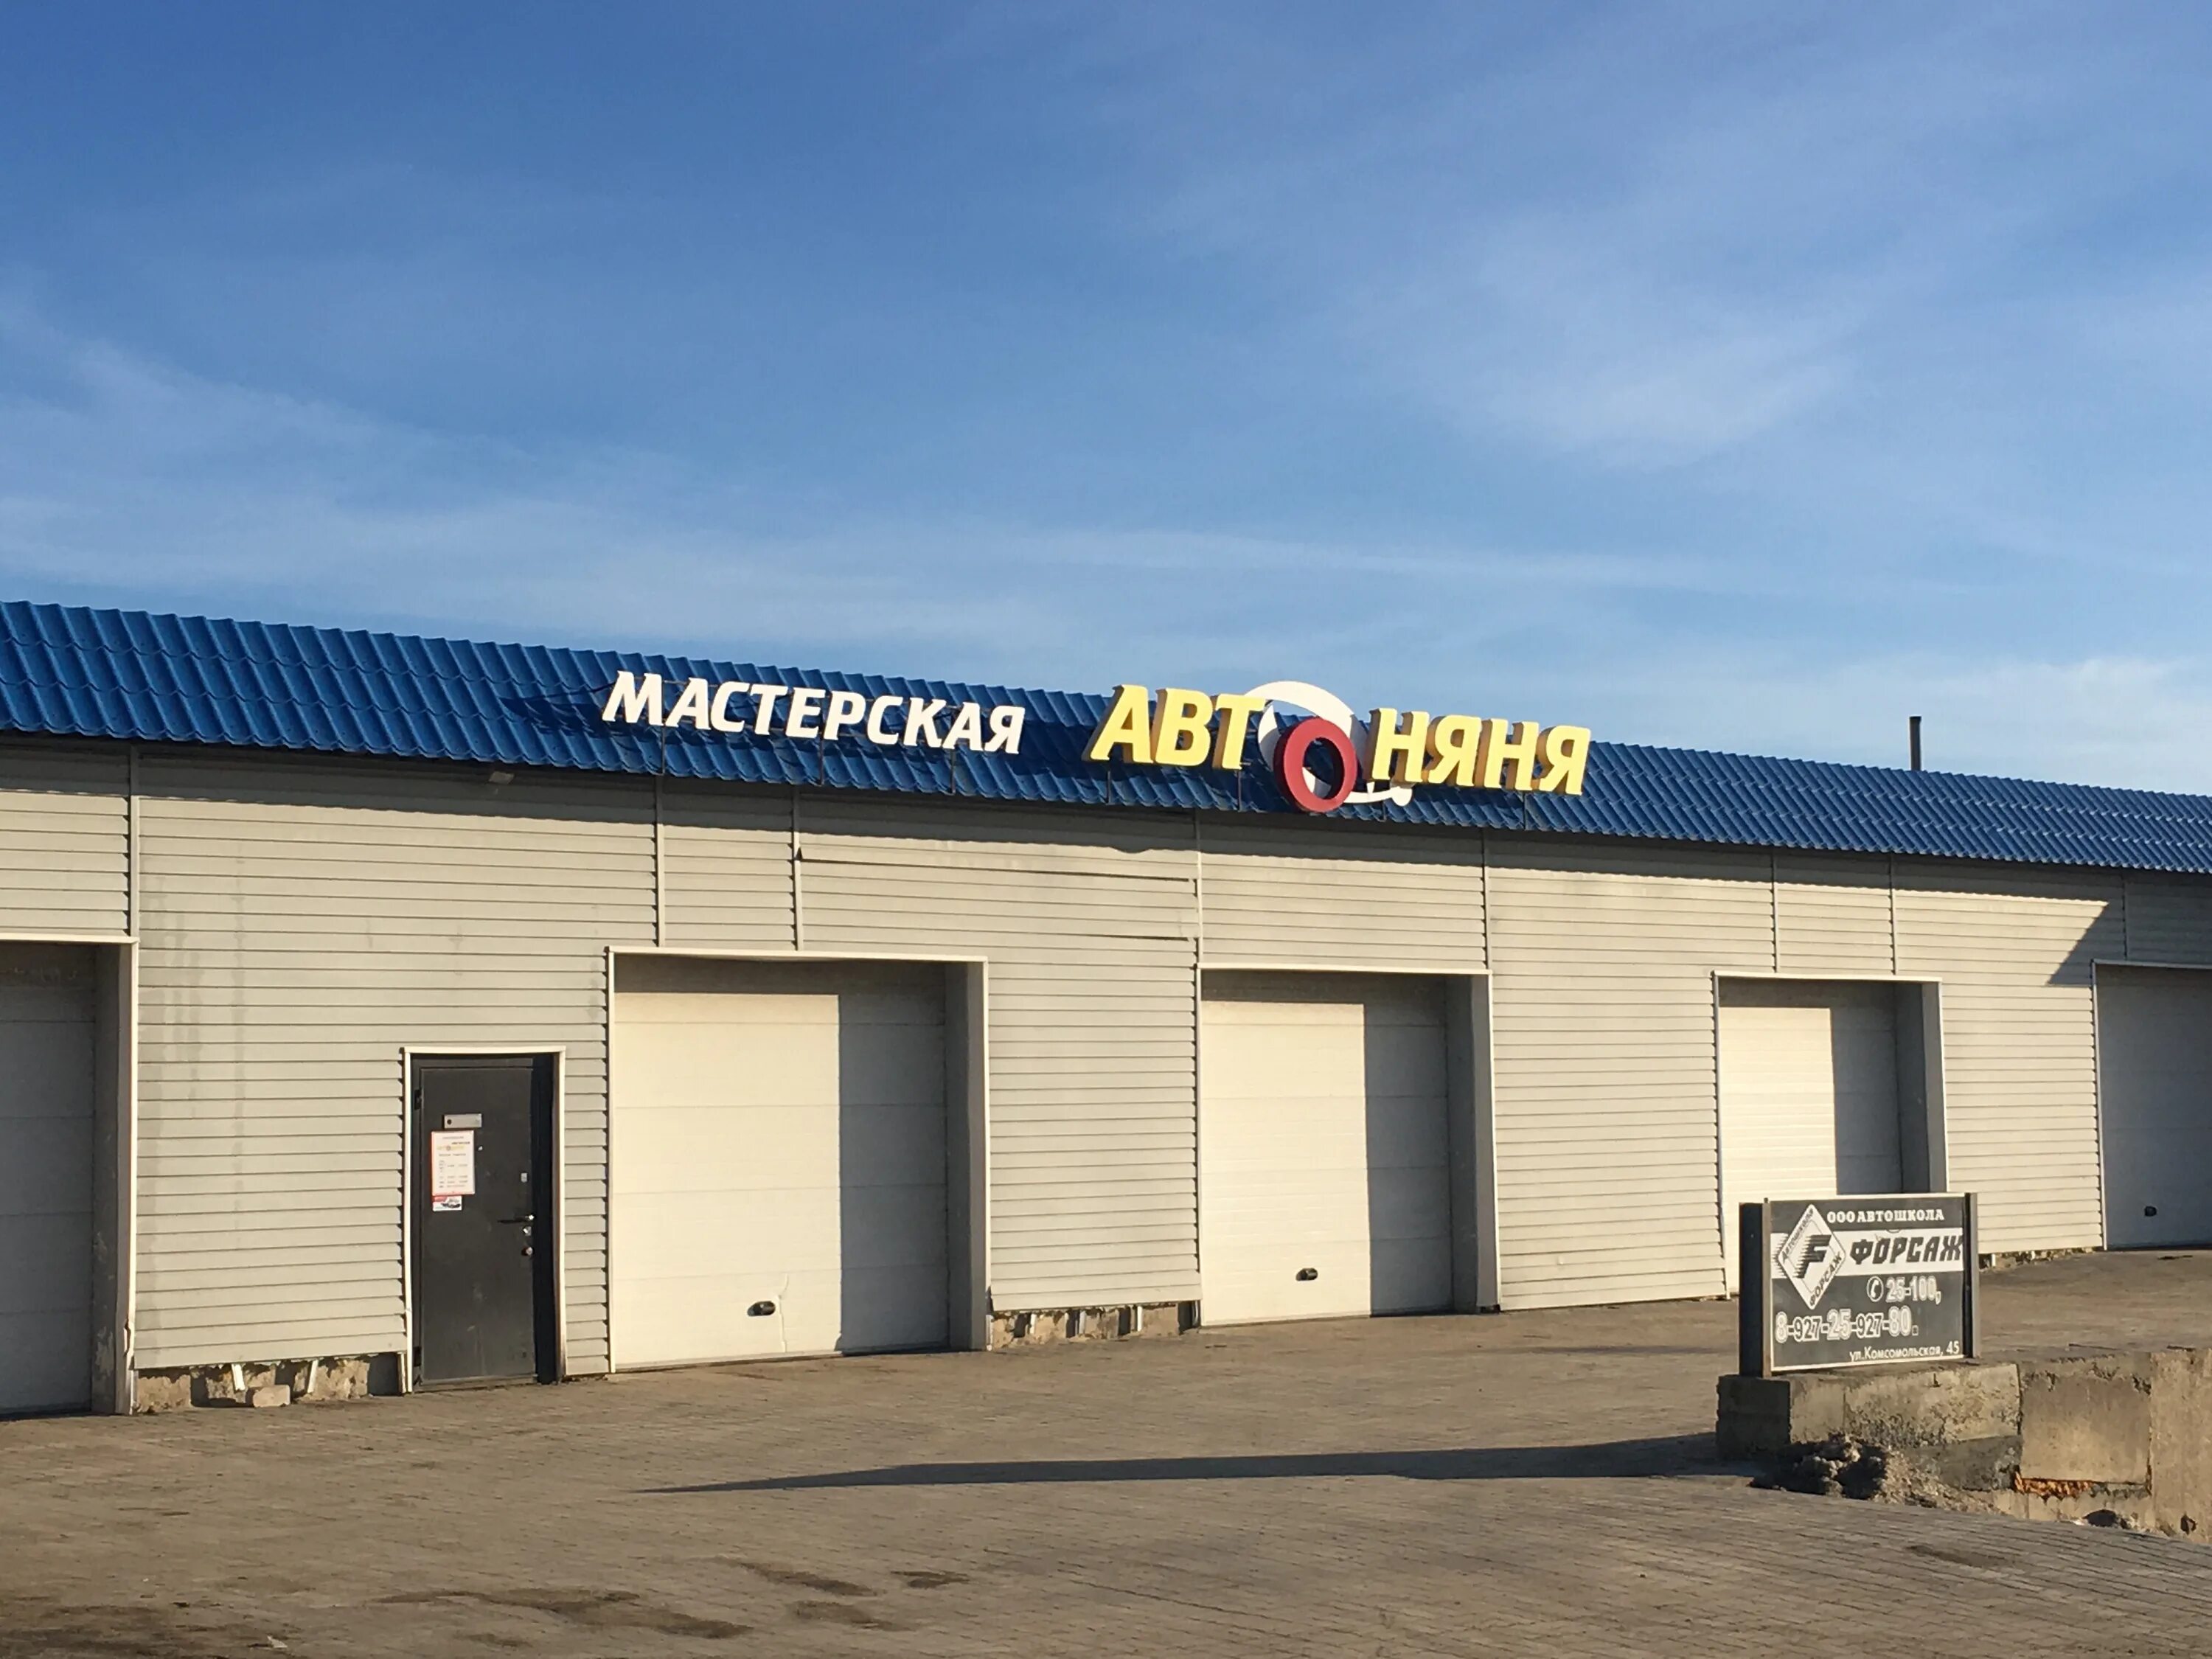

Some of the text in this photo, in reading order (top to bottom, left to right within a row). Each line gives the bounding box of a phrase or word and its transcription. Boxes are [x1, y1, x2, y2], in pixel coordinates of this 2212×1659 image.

[601, 670, 1026, 755] МАСТЕРСКАЯ
[1826, 1208, 1944, 1223] ООО АВТОШКОЛА
[1850, 1236, 1963, 1265] ФОРСАЖ
[1809, 1251, 1842, 1306] ФОРСАЖ
[1946, 1340, 1960, 1354] 45
